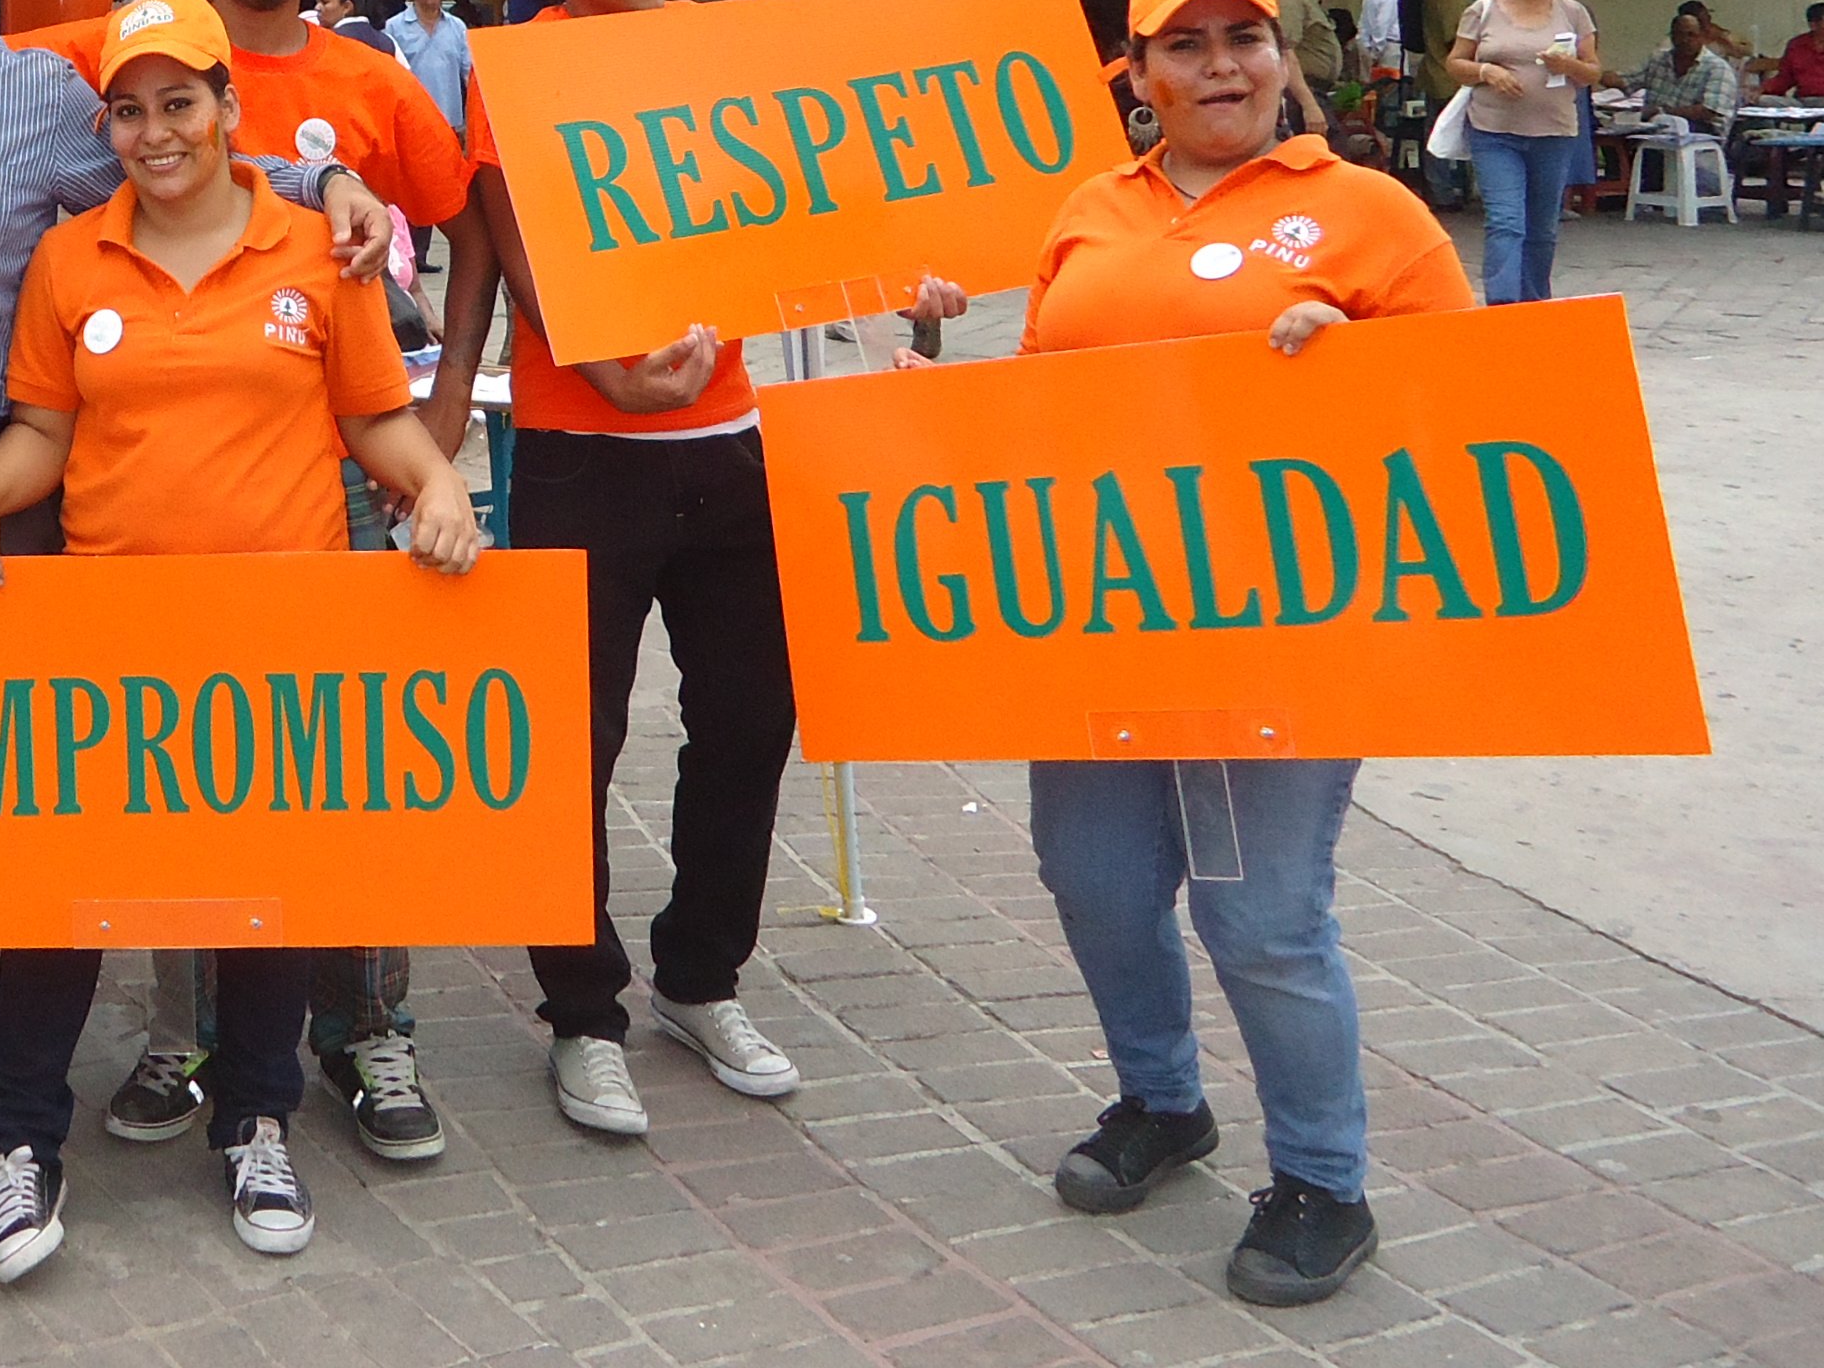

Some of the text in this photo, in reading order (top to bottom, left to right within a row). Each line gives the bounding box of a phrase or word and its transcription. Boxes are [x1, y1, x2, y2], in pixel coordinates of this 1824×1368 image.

[555, 50, 1074, 251] RESPETO
[1248, 238, 1312, 269] PINU
[263, 322, 307, 345] PINU
[840, 440, 1588, 642] IGUALDAD
